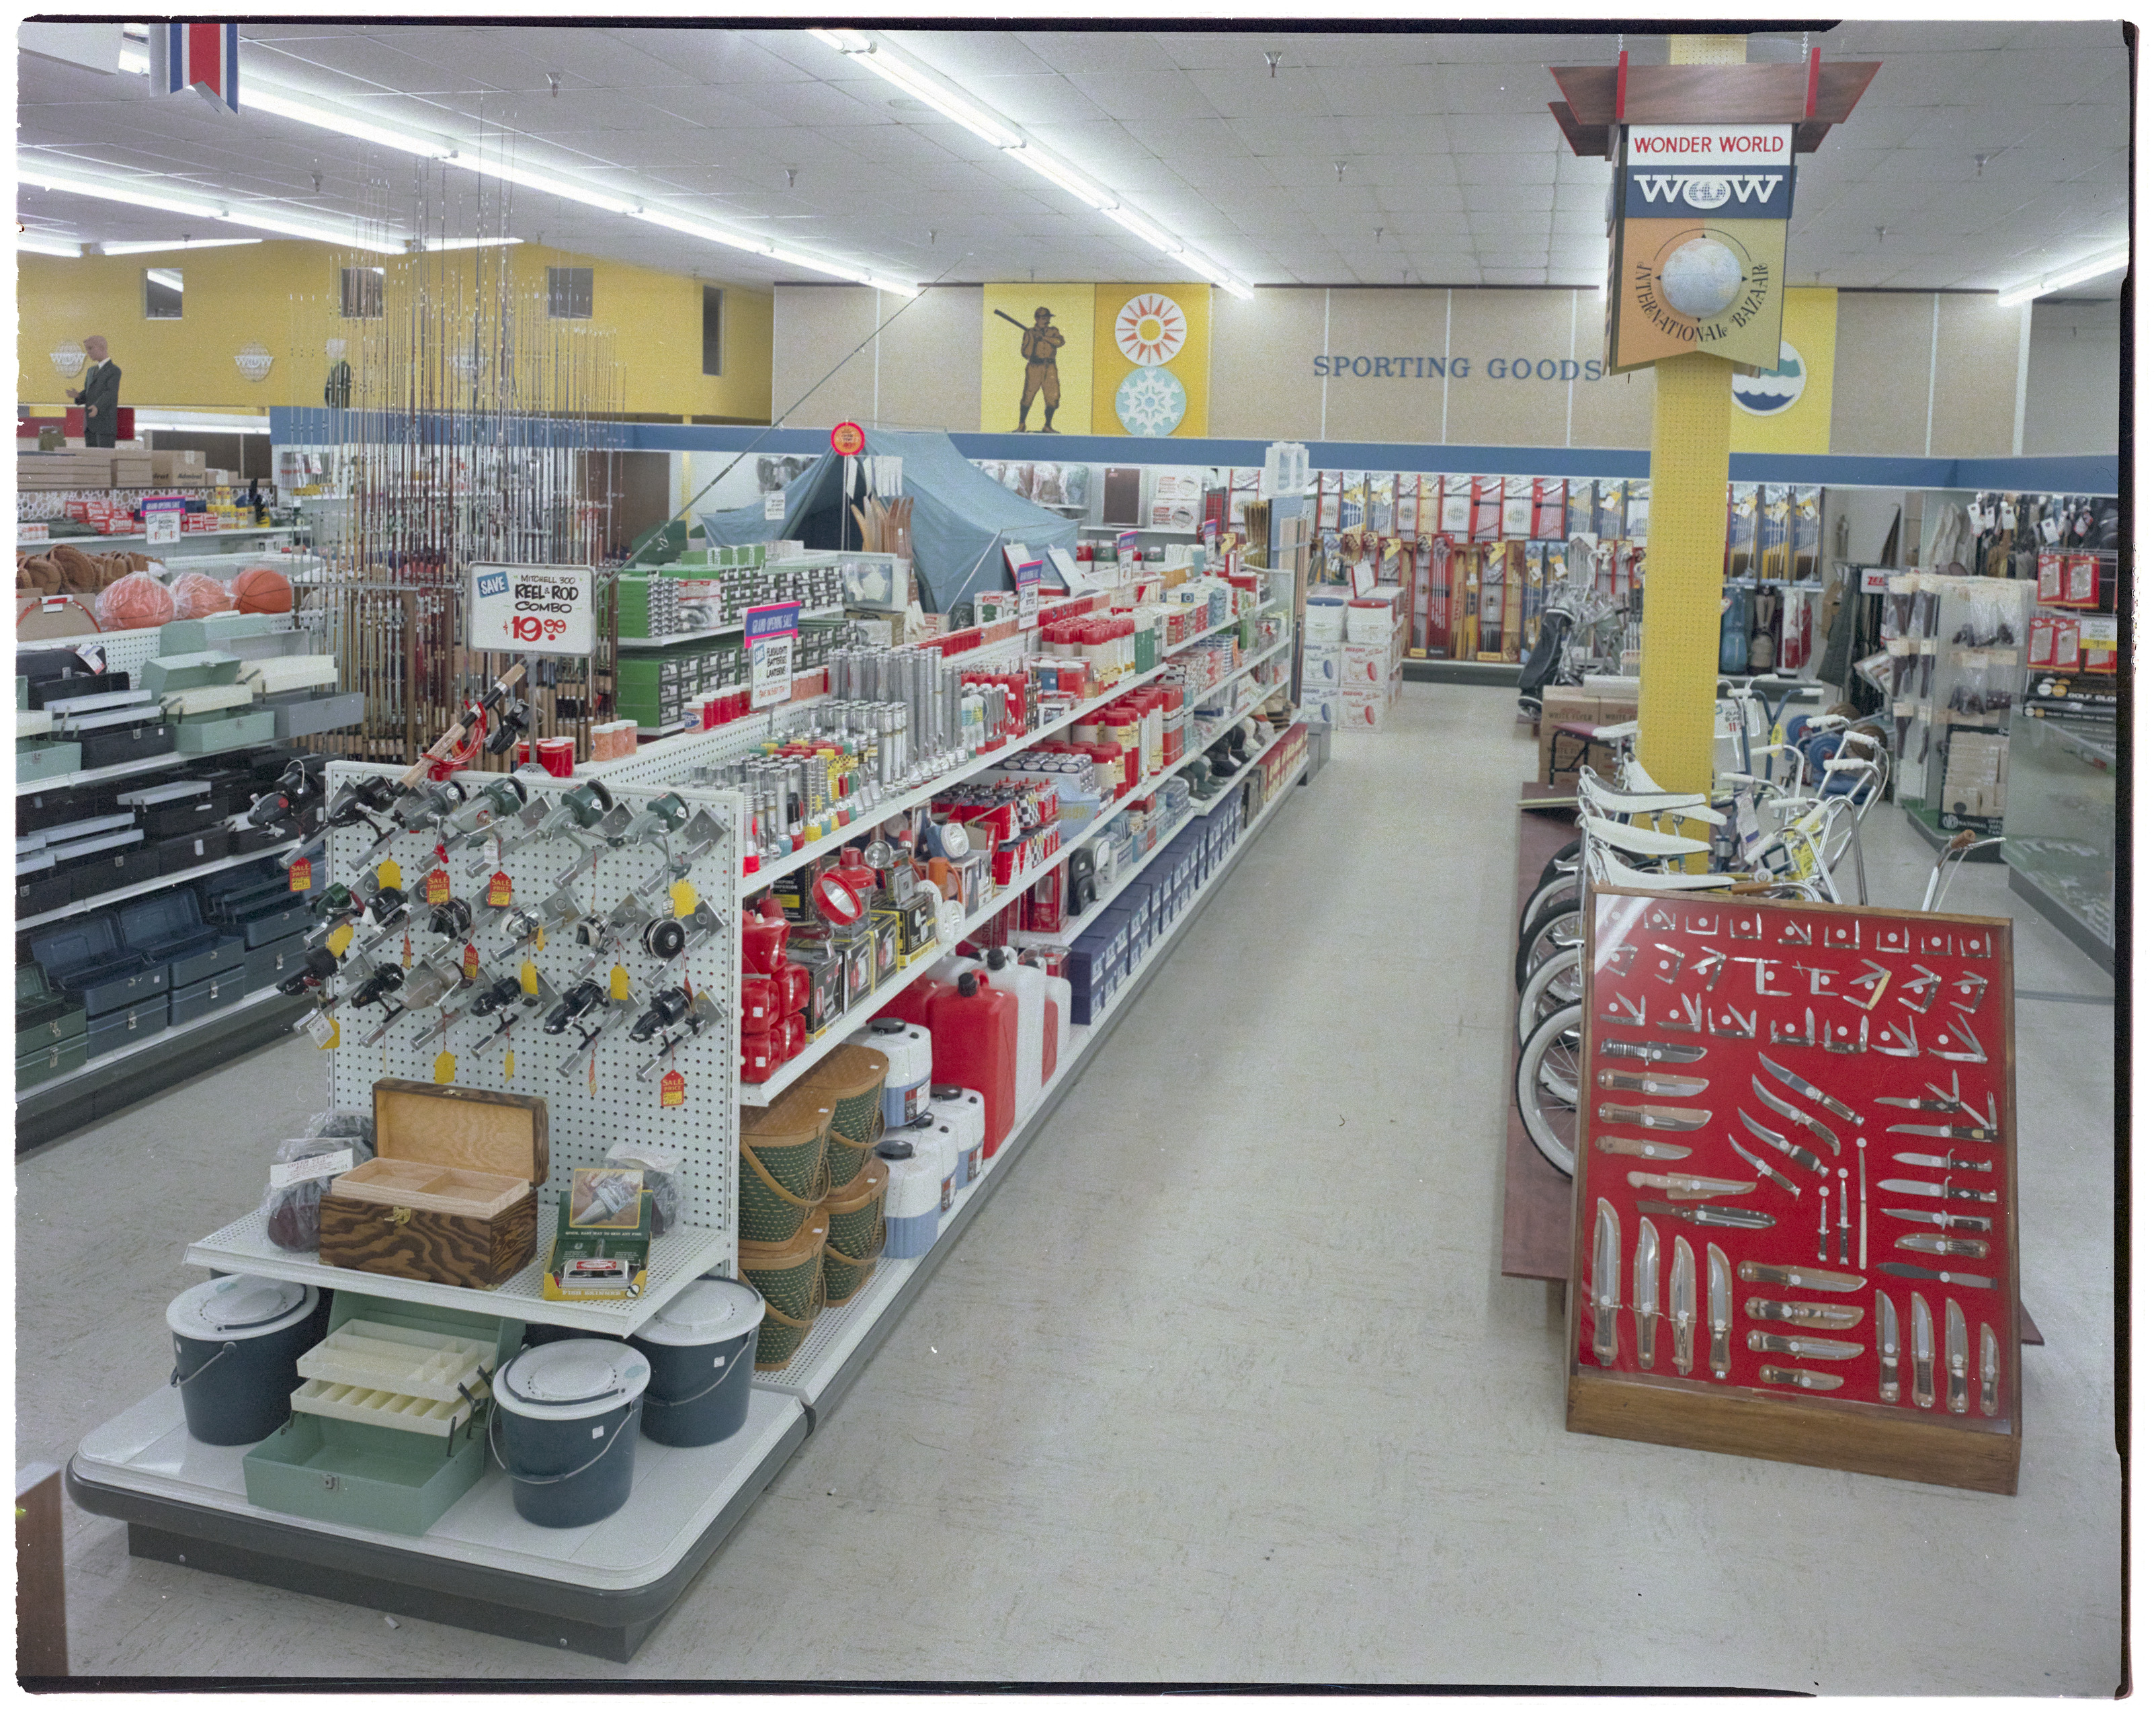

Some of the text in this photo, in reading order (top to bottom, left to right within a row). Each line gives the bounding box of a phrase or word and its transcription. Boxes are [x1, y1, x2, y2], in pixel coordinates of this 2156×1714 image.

[1634, 136, 1784, 153] WONDER WORLD
[1634, 175, 1783, 209] WOW
[1635, 261, 1769, 342] INTERNATIONAL BAZAAR
[1313, 356, 1602, 381] SPORTING GOODS
[110, 519, 132, 531] Sterno
[481, 576, 505, 596] SAVE
[521, 575, 576, 585] MITCHELL 300
[515, 584, 545, 600] REEL
[552, 585, 579, 600] ROD
[515, 601, 572, 613] COMBO
[291, 863, 310, 872] SALE
[429, 876, 449, 885] SALE
[465, 950, 477, 959] SALE
[663, 1078, 683, 1086] SALE
